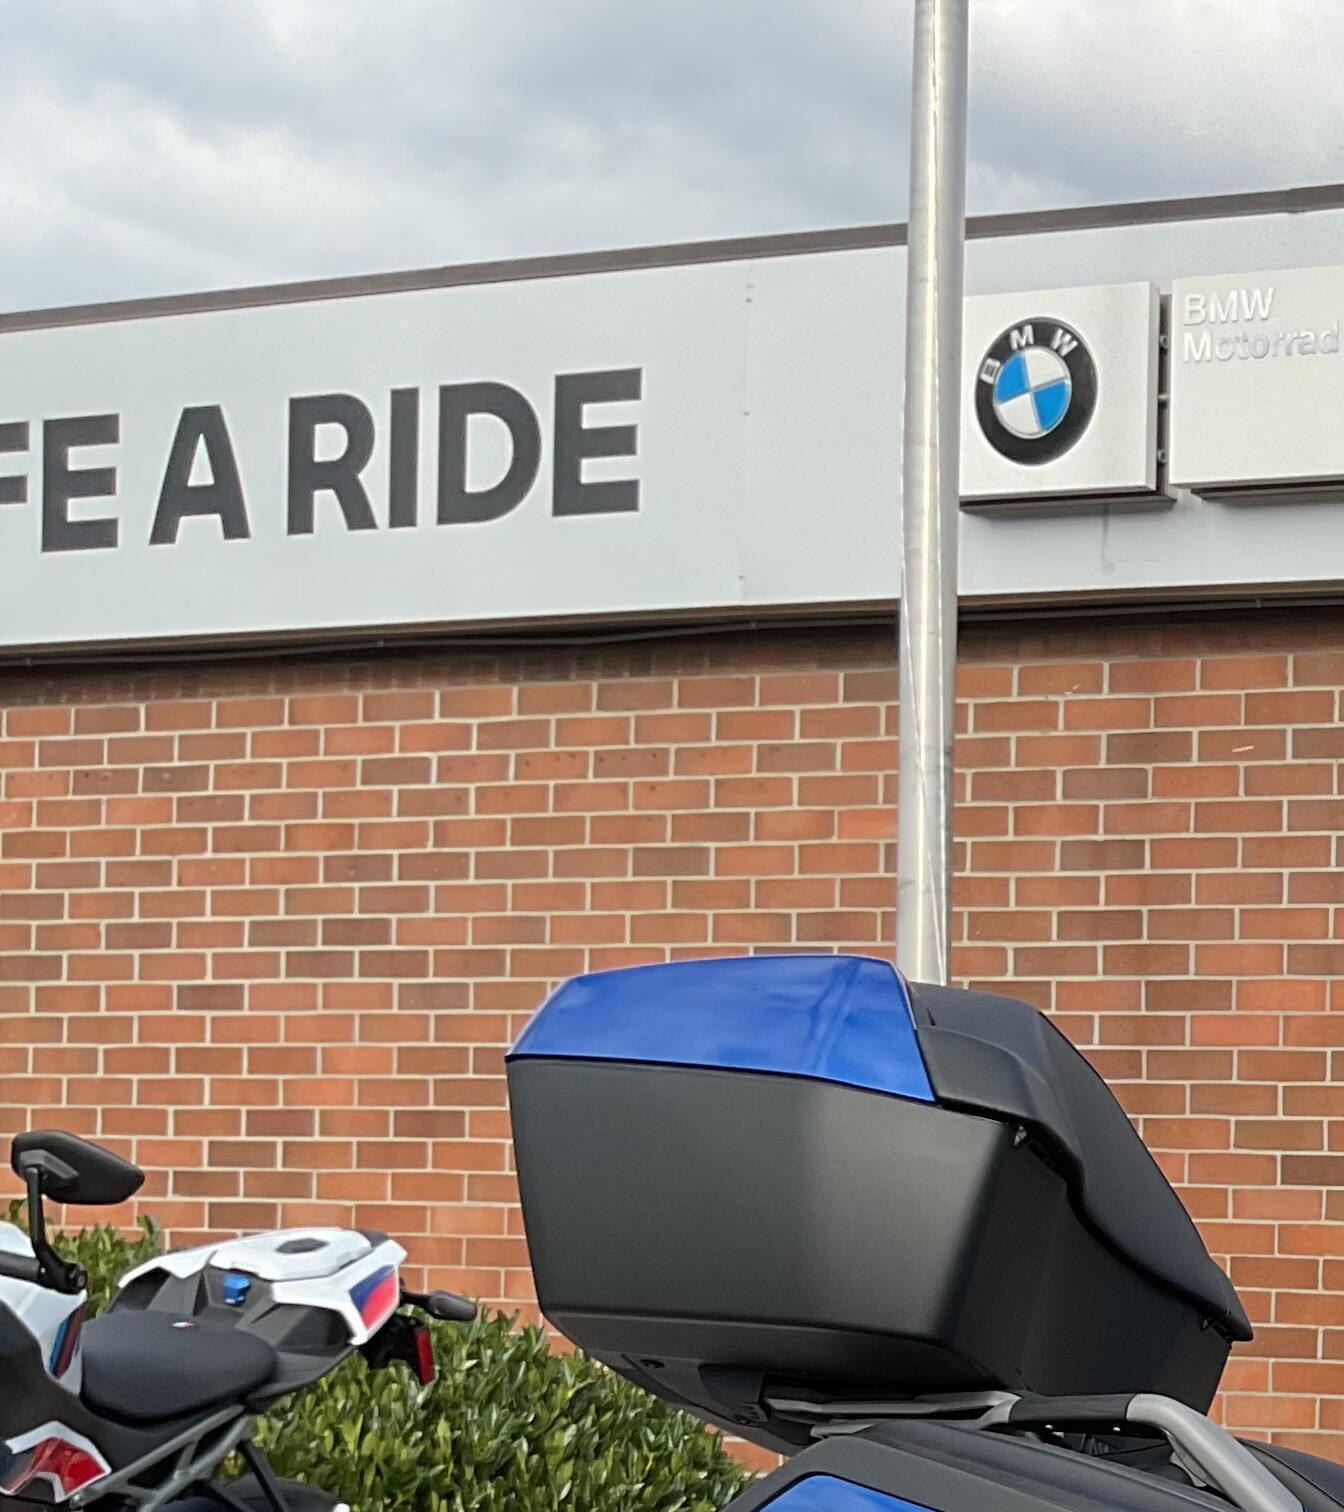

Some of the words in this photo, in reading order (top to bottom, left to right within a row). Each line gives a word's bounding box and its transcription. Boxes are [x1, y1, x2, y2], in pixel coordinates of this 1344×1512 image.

[1183, 287, 1274, 327] BMW
[980, 323, 1078, 385] BMW
[1182, 320, 1340, 364] Motorrad
[148, 403, 252, 546] A
[286, 366, 644, 537] RIDE
